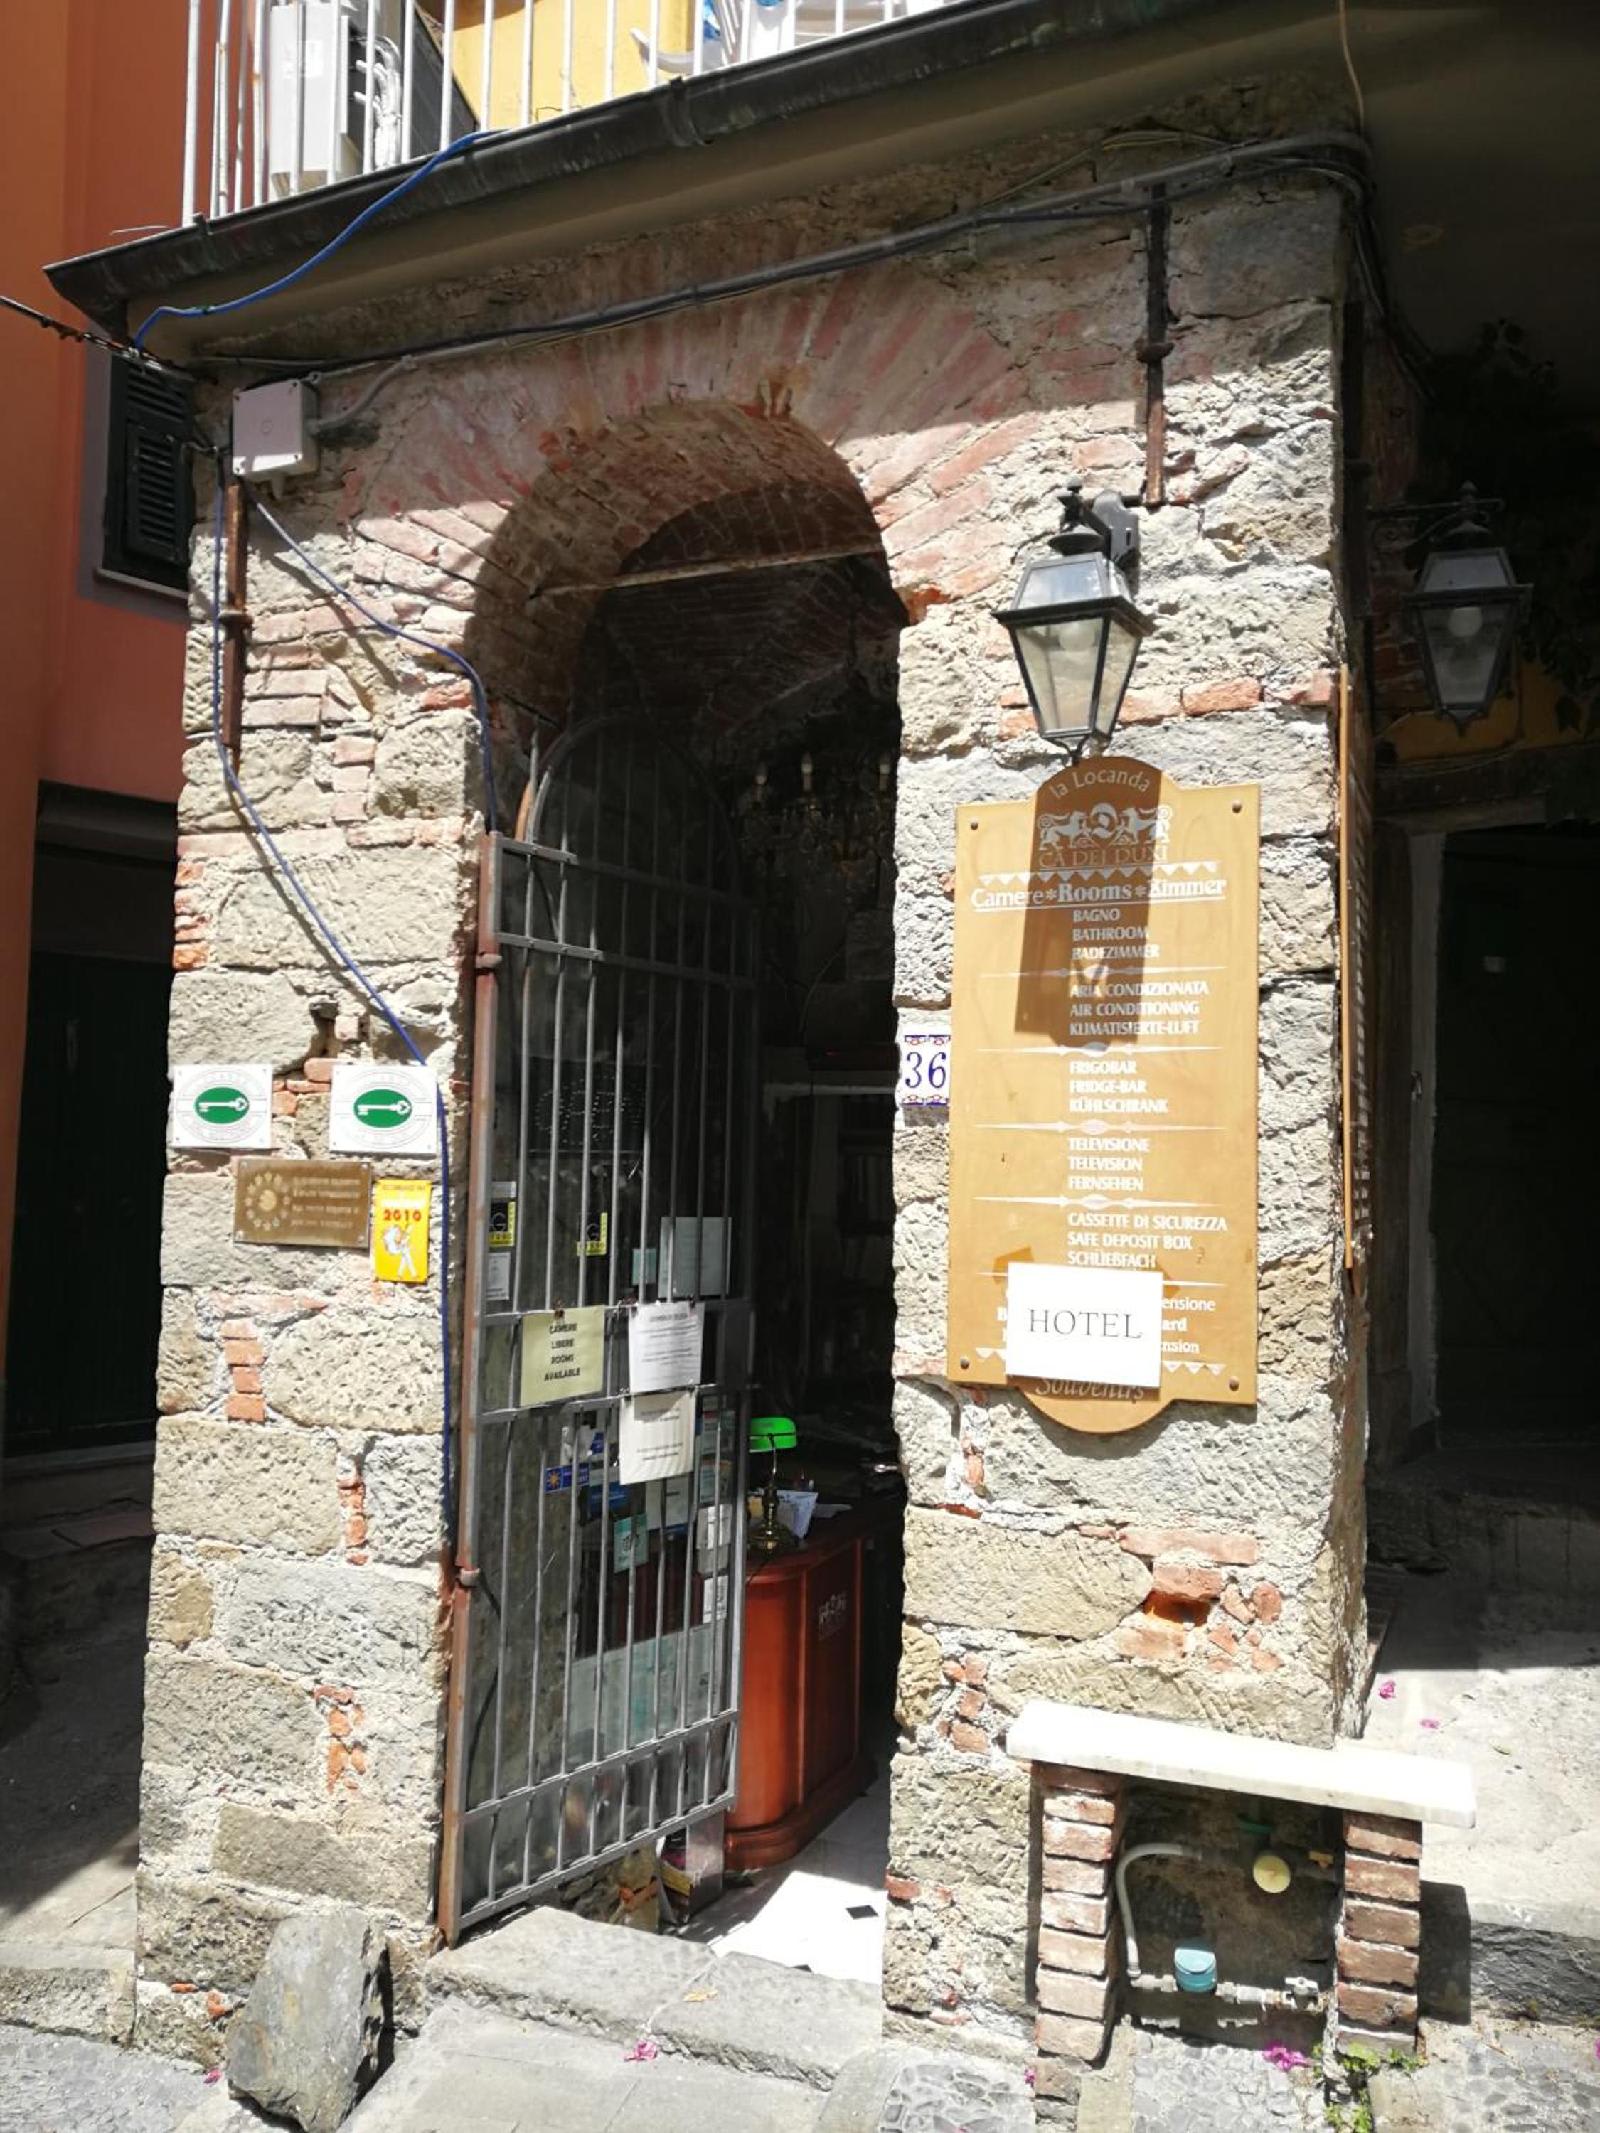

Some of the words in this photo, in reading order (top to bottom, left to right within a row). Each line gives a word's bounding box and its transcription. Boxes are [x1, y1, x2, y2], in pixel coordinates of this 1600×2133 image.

[1050, 783, 1069, 798] la
[1072, 767, 1150, 793] Locanda
[1115, 844, 1168, 864] DUXI
[971, 887, 1044, 908] Camere
[1058, 882, 1132, 902] Rooms
[1148, 878, 1227, 898] Zimmer
[1073, 908, 1121, 922] BAGNO
[1073, 926, 1150, 941] BATHROOM
[1072, 944, 1160, 960] BADEZIMMER
[1070, 984, 1103, 997] ARIA
[1107, 981, 1209, 996] CONDIZIONATA
[1070, 1004, 1092, 1017] AIR
[1096, 1001, 1200, 1016] CONDITIONING
[905, 1051, 946, 1089] 36
[1070, 1060, 1136, 1074] FRIGOBAR
[1070, 1080, 1147, 1093] FRIDGE-BAR
[1068, 1137, 1150, 1152] TELEVISIONE
[1068, 1156, 1143, 1171] TELEVISION
[1068, 1176, 1143, 1191] FERNSEHEN
[1067, 1213, 1130, 1228] CASSETTE
[1133, 1214, 1149, 1229] DI
[1153, 1215, 1228, 1231] SICUREZZA
[1067, 1232, 1099, 1247] SAFE
[1102, 1233, 1160, 1249] DEPOSIT
[1162, 1235, 1193, 1250] BOX
[1162, 1297, 1216, 1313] ensione
[1029, 1308, 1143, 1339] HOTEL
[1162, 1339, 1200, 1353] nsion
[551, 1354, 574, 1365] ROOMS
[544, 1367, 580, 1382] AVAILABLE
